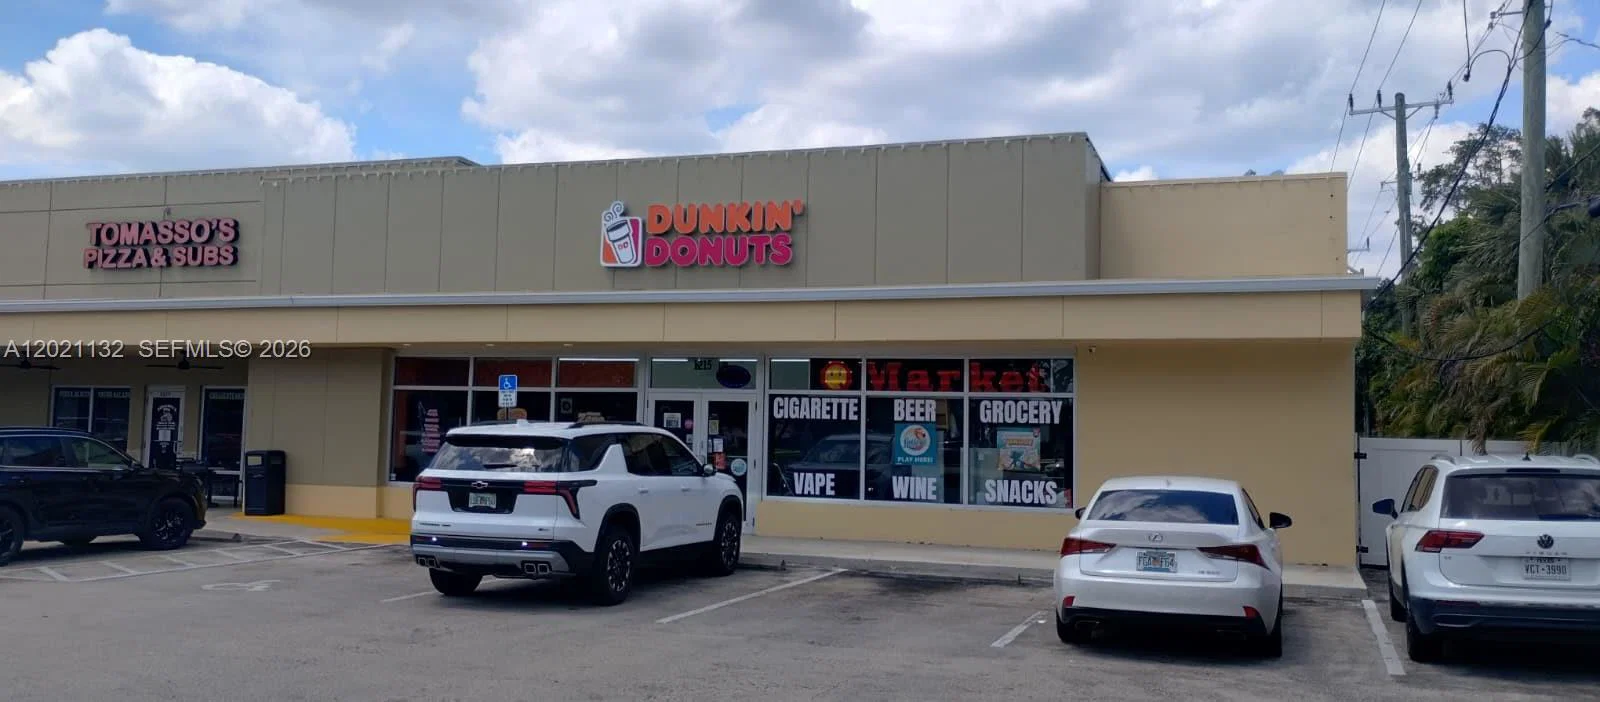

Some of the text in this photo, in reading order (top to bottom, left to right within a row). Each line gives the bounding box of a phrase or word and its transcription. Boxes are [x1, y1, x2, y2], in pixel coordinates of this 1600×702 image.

[646, 199, 804, 234] DUNKIN'
[87, 218, 239, 247] TOMASSO'S
[83, 248, 148, 269] PIZZA
[173, 246, 236, 267] SUBS
[644, 233, 792, 267] DONUTS
[866, 362, 1047, 392] Market
[773, 397, 859, 421] CIGARETTE
[893, 398, 937, 422] BEER
[979, 400, 1063, 425] GROCERY
[793, 472, 836, 496] VAPE
[892, 475, 937, 500] WINE
[984, 479, 1058, 505] SNACKS
